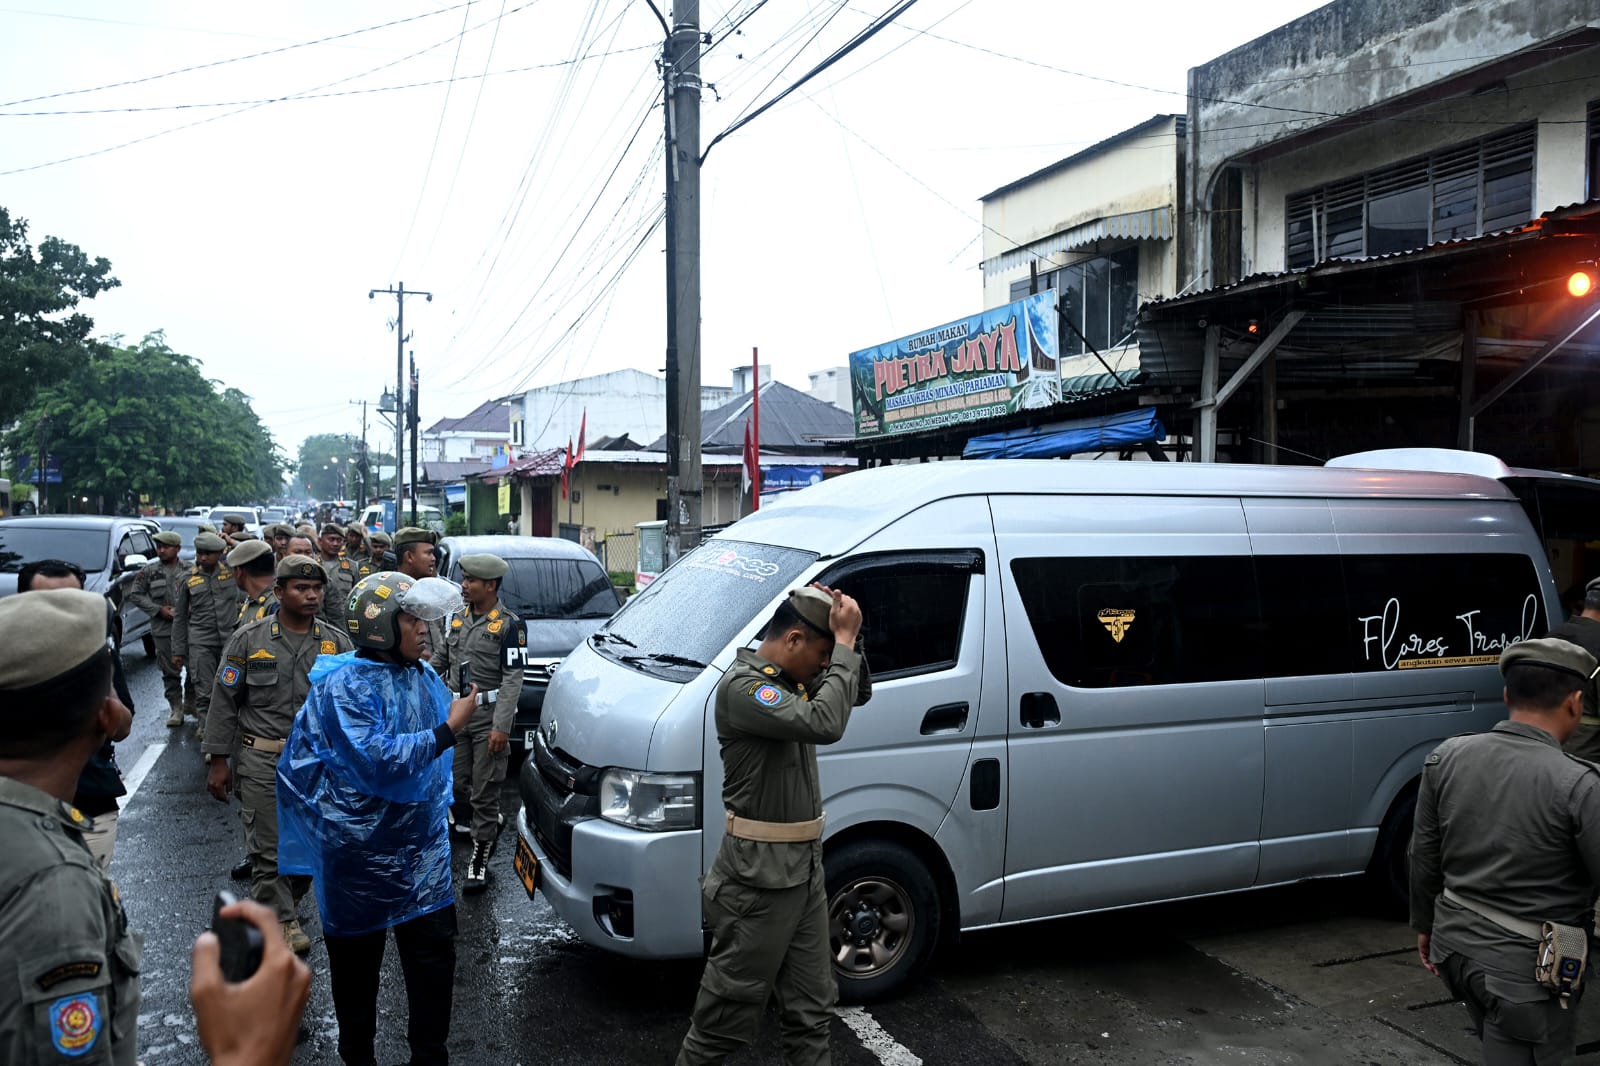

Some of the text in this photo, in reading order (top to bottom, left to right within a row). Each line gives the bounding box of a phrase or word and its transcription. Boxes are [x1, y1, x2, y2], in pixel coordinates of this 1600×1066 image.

[908, 323, 968, 351] RUMAH MAKAN
[951, 315, 1020, 374] JAYA
[886, 394, 915, 410] MASAKAN
[916, 390, 934, 405] KHAS
[935, 383, 964, 401] MINANG
[965, 375, 1006, 395] PARIAMAN
[962, 410, 976, 421] 0813
[1358, 593, 1537, 670] Flores Travel
[1400, 659, 1442, 668] angkutan
